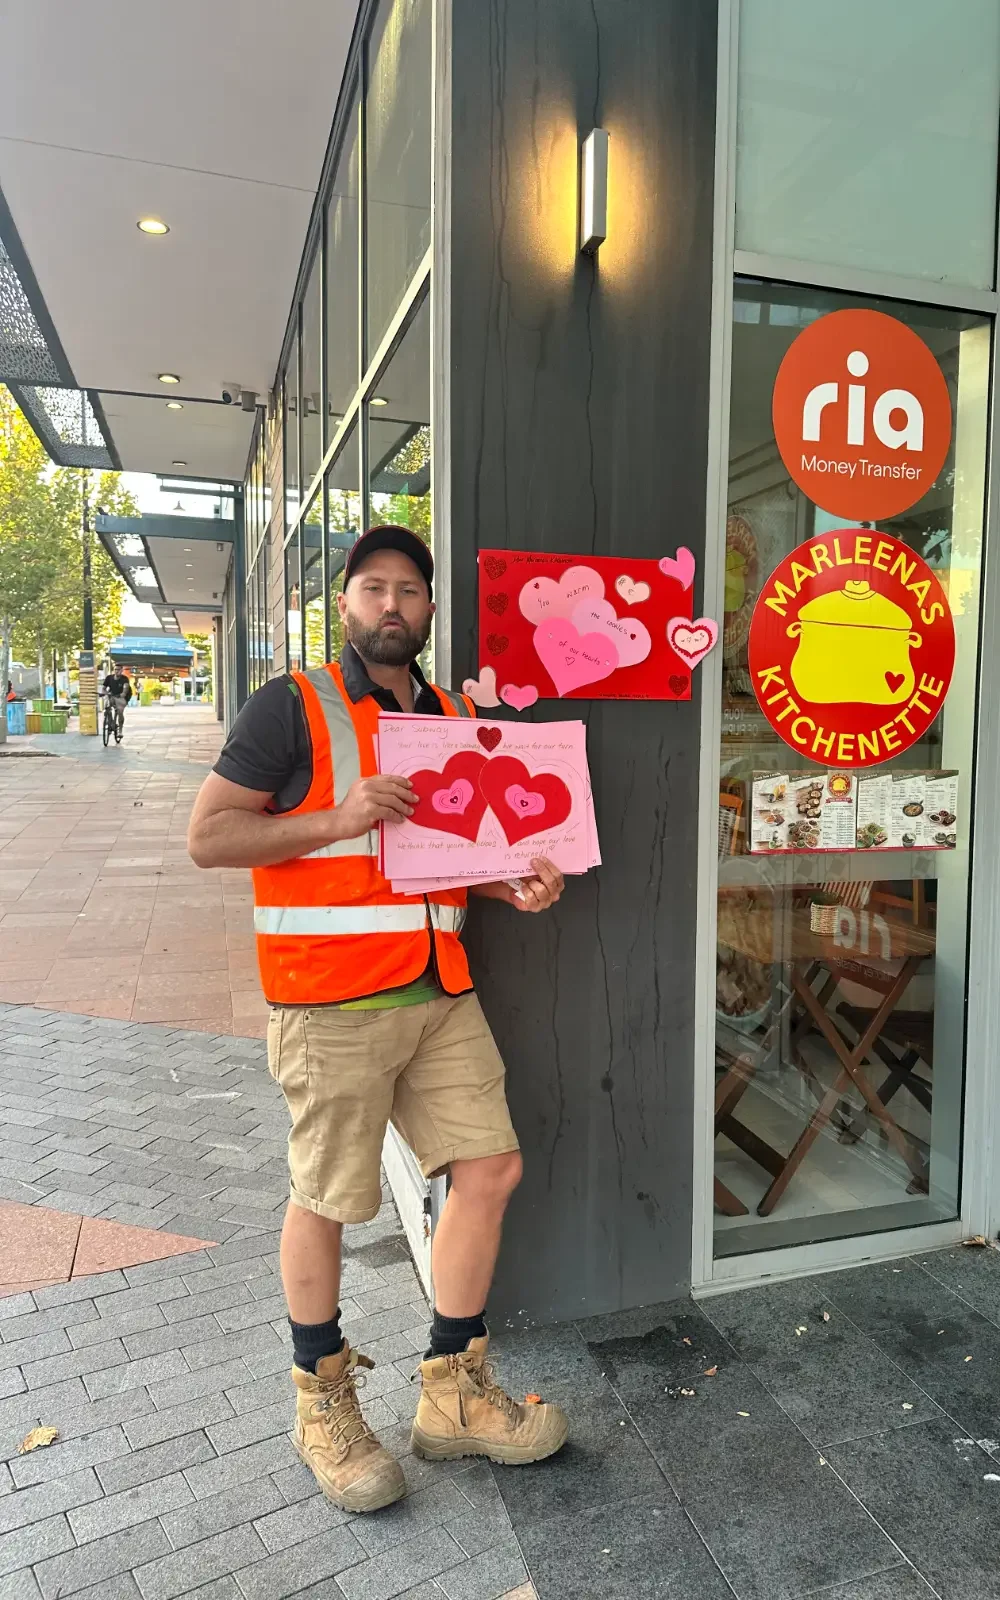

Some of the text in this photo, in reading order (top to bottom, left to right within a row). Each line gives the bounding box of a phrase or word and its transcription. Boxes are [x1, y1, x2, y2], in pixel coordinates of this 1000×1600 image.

[802, 350, 925, 452] ria
[801, 455, 922, 481] Money Transfer
[566, 584, 590, 599] warm
[764, 536, 945, 627] MARLEENAS
[590, 611, 628, 635] the cookies
[558, 640, 601, 666] of our hearts
[757, 665, 945, 761] KITCHENETTE
[383, 723, 449, 740] Dear Subway
[428, 841, 445, 849] that
